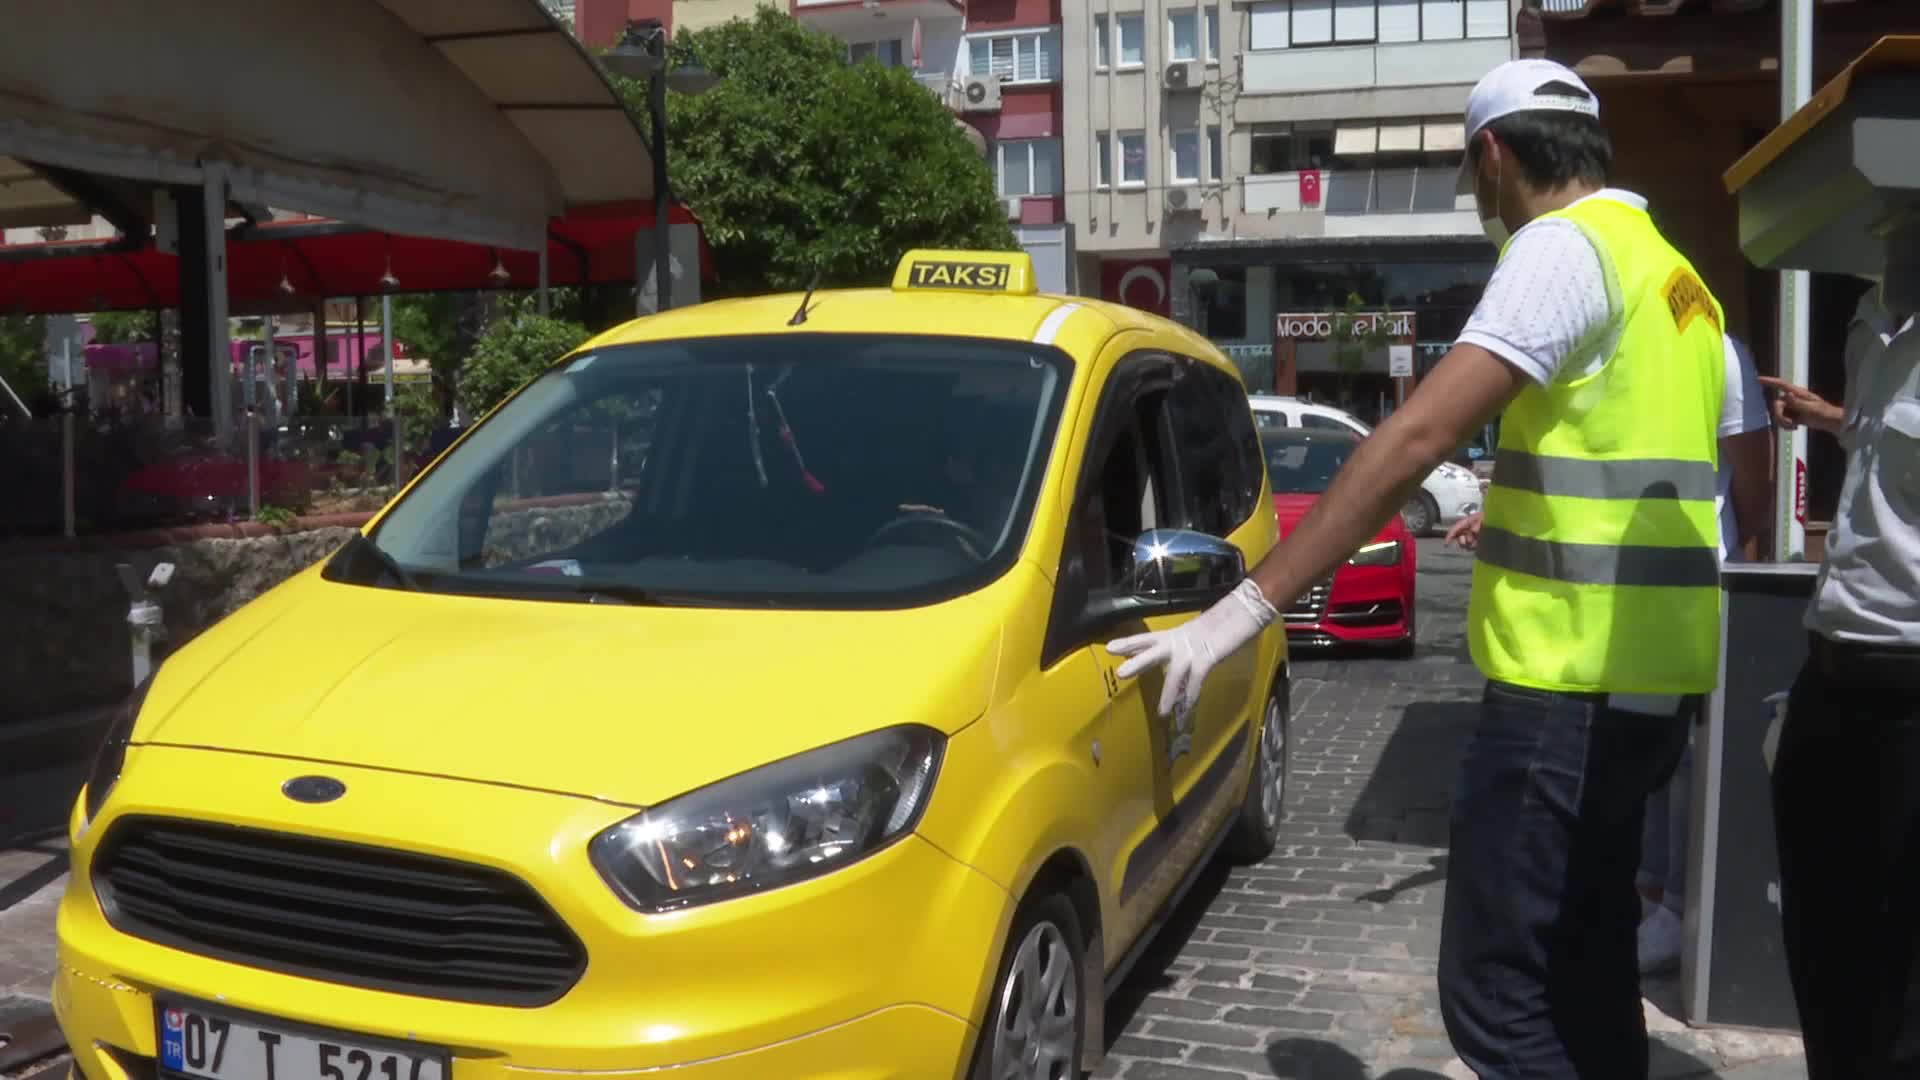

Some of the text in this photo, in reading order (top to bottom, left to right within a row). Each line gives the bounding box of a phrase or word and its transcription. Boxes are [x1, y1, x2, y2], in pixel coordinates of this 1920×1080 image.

[165, 1039, 182, 1059] TR
[185, 1013, 231, 1074] 07
[258, 1030, 281, 1080] T
